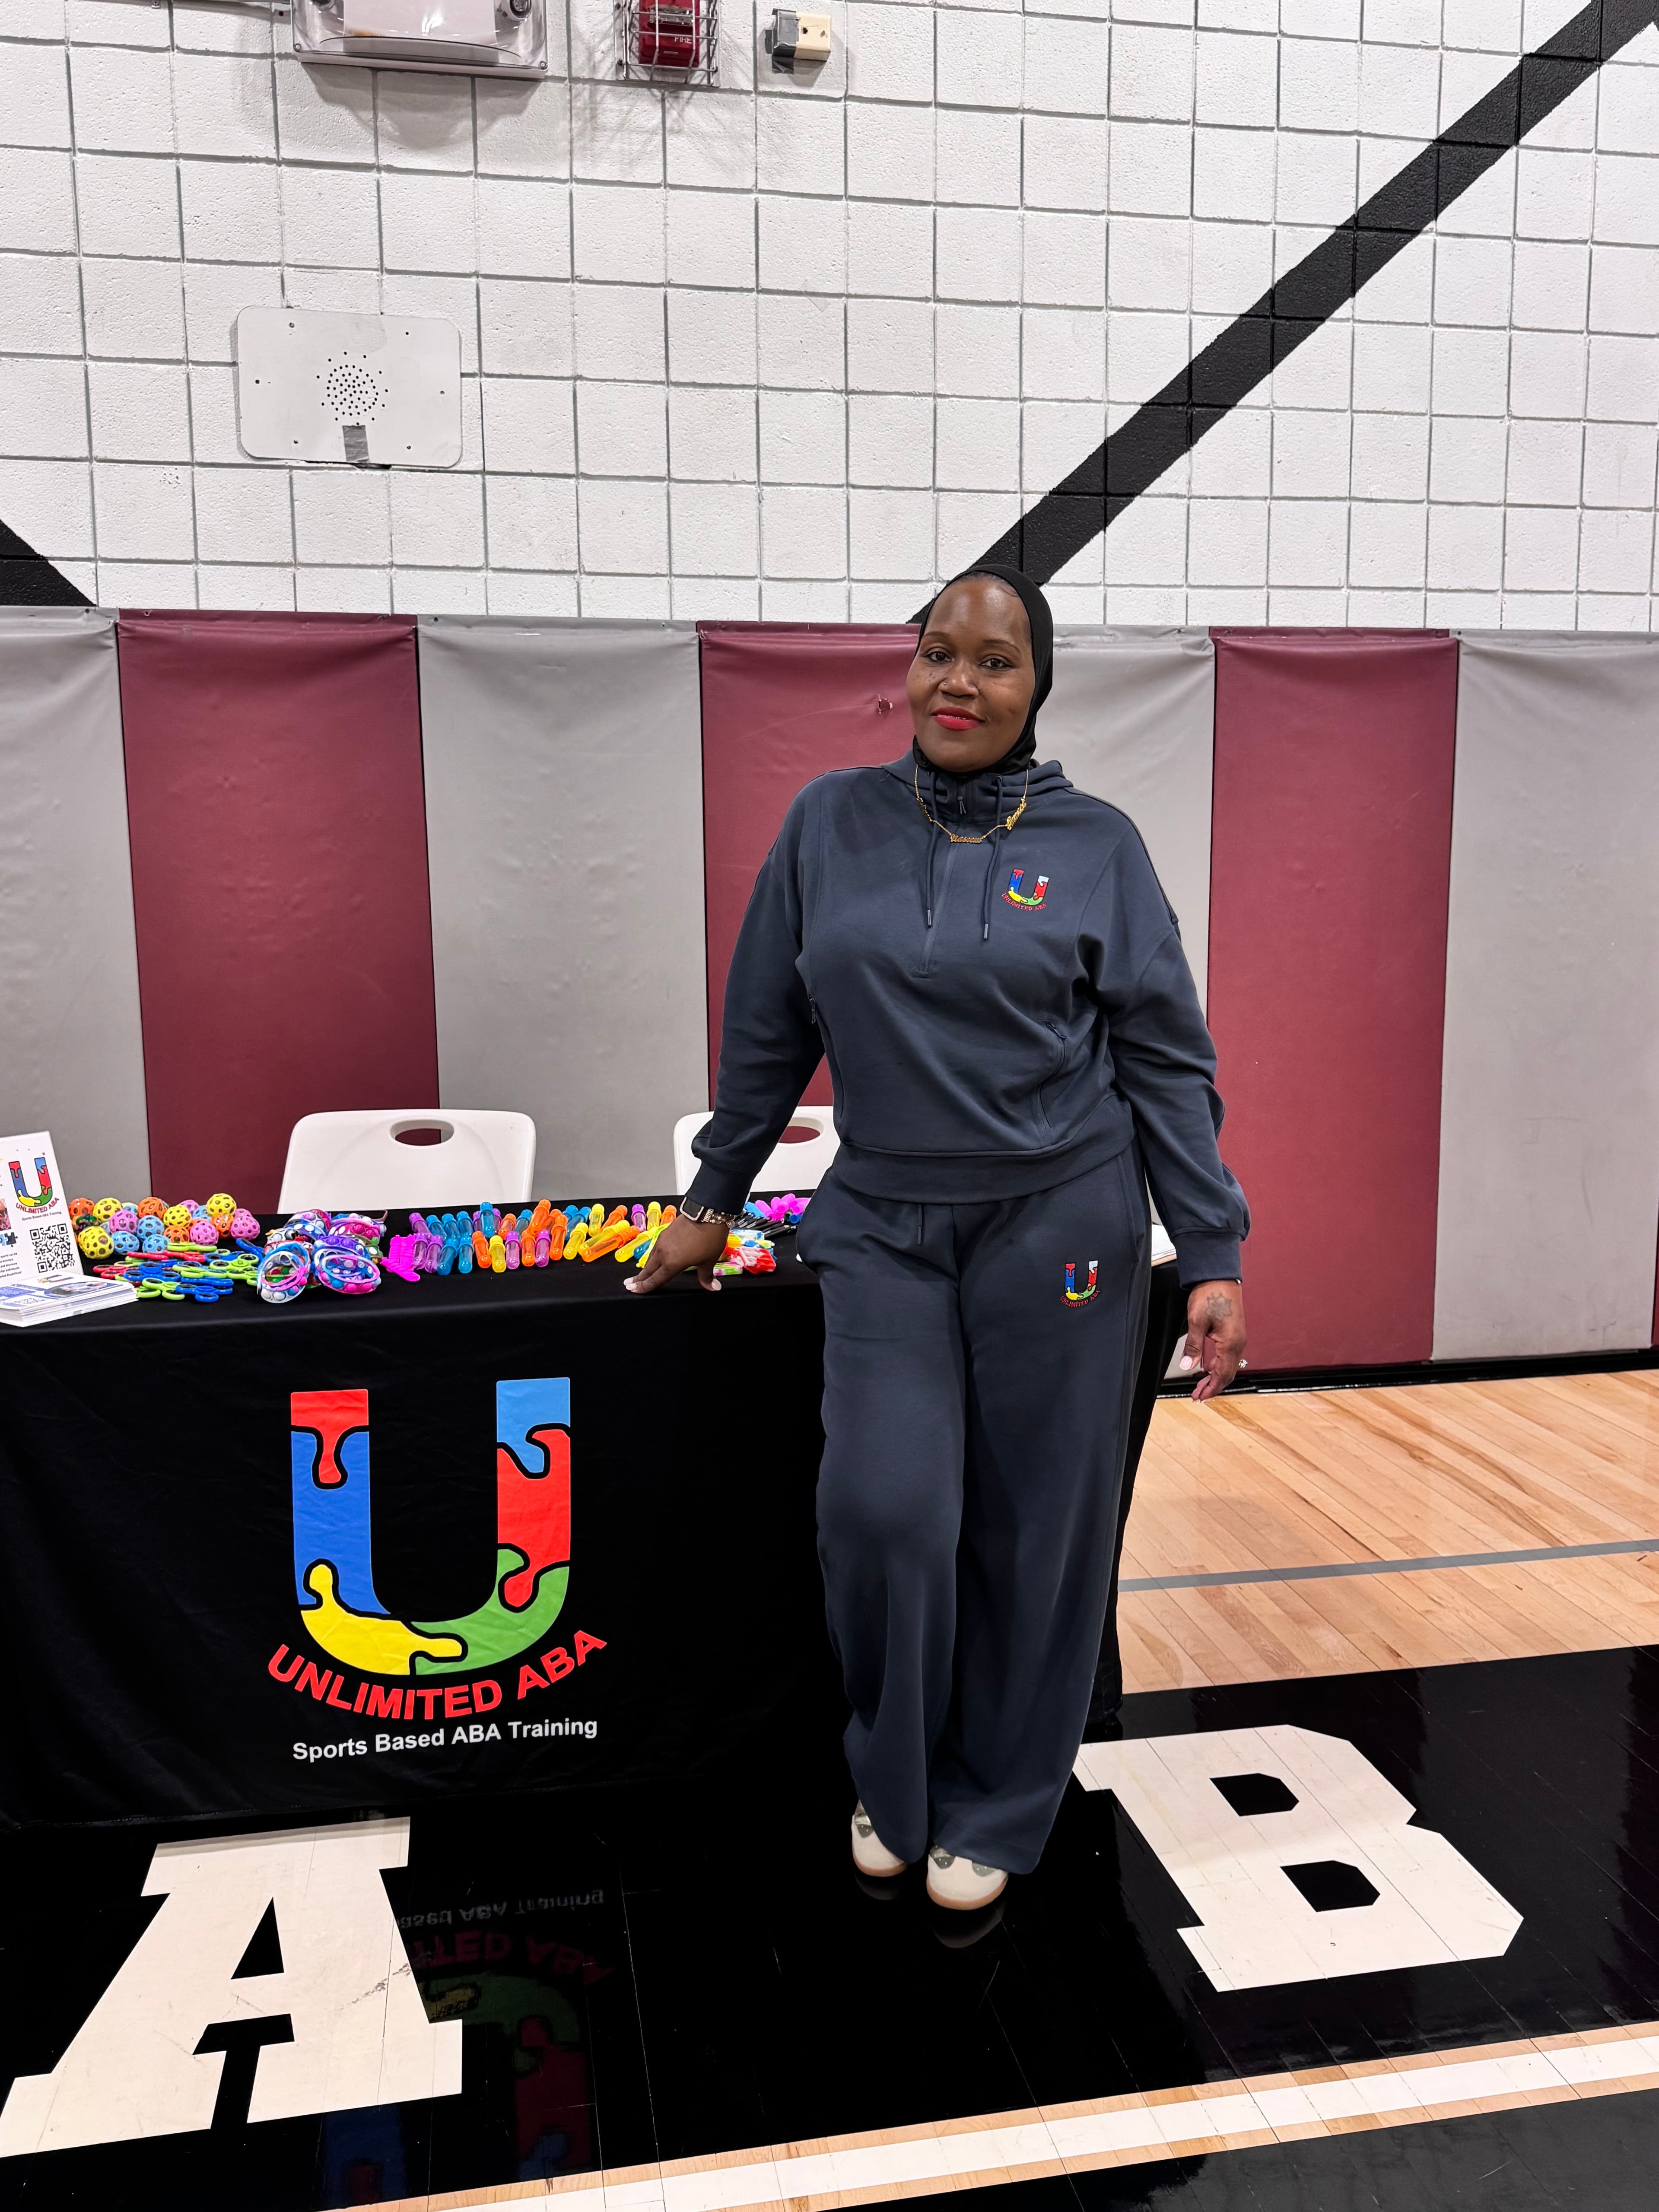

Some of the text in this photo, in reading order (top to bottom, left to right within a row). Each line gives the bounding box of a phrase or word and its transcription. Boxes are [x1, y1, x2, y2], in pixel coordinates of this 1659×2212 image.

[16, 1202, 48, 1214] UNLIMITED
[290, 1377, 571, 1676] U
[267, 1630, 607, 1720] UNLIMITED ABA
[293, 1717, 597, 1763] Sports Based ABA Training
[0, 1724, 1524, 2158] A B
